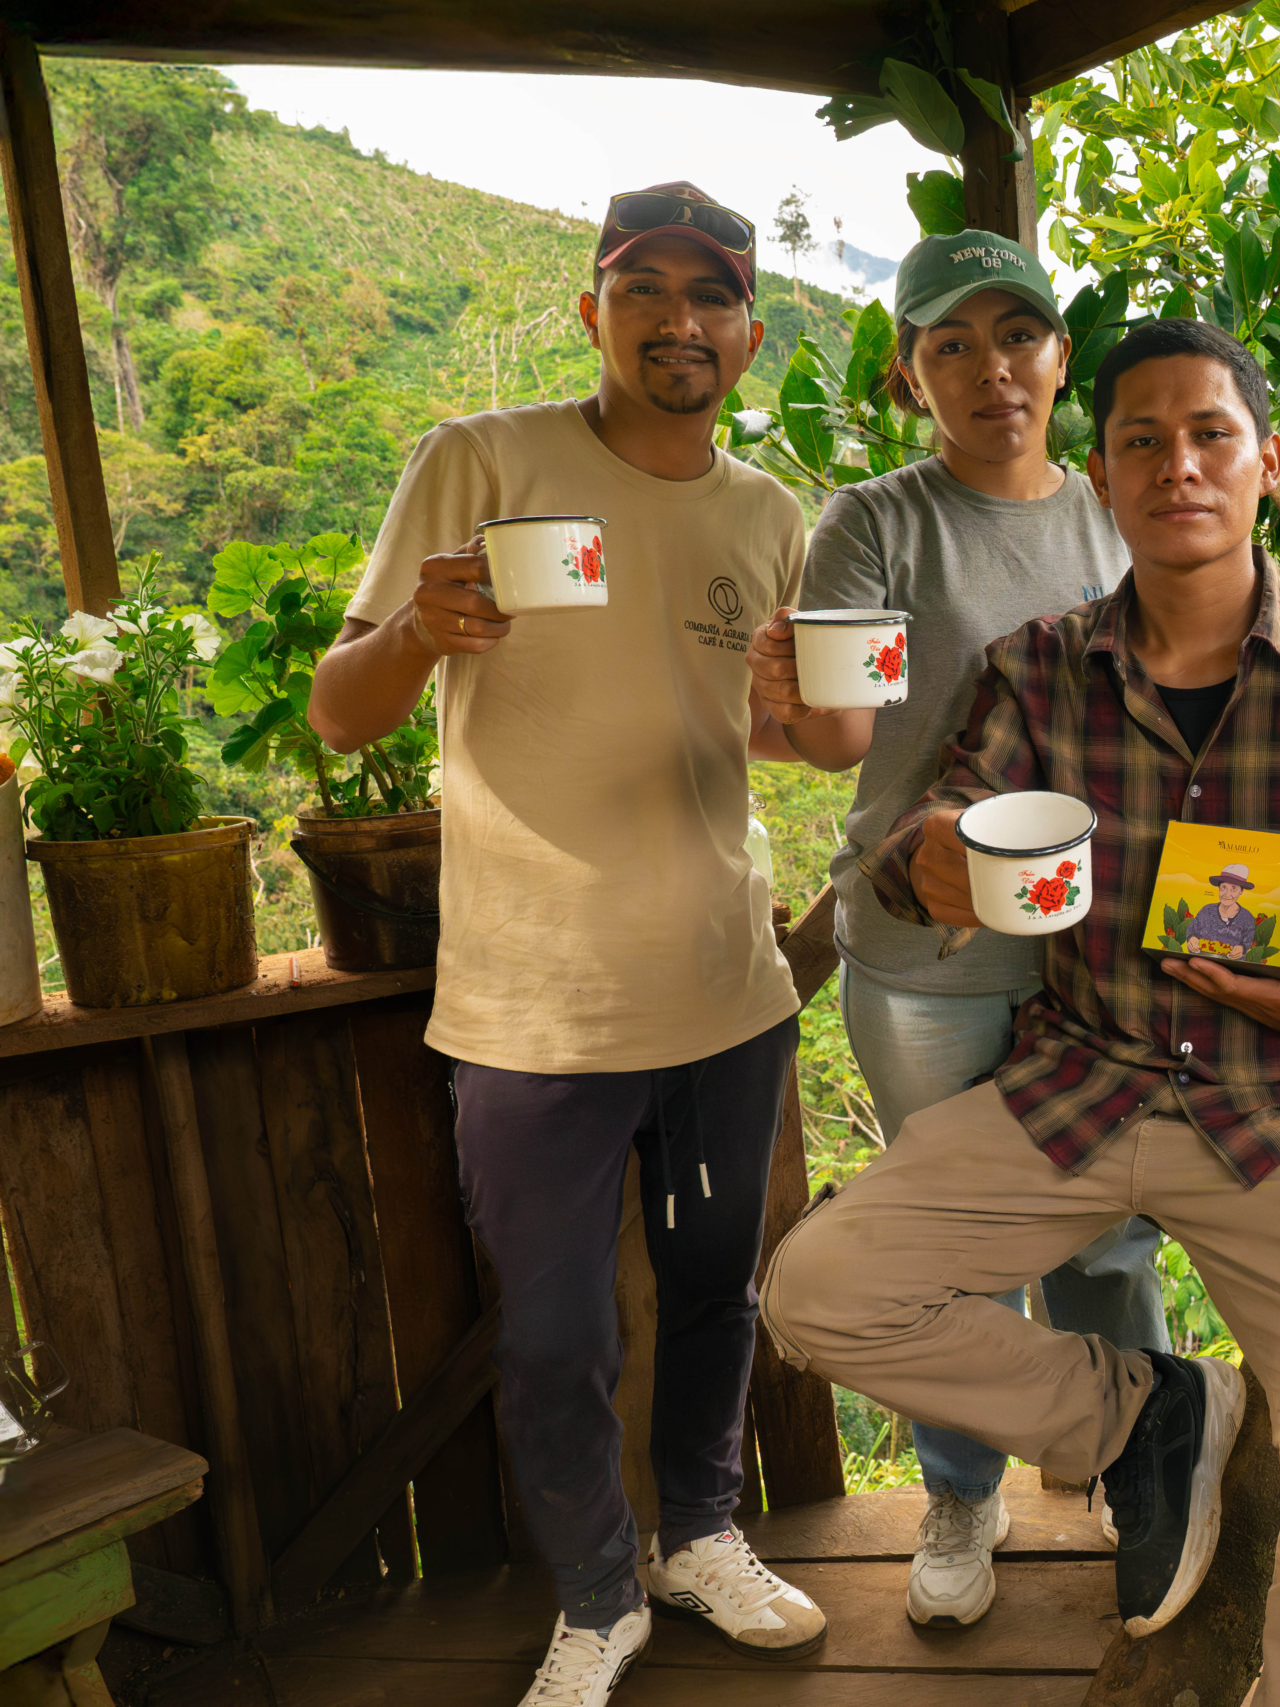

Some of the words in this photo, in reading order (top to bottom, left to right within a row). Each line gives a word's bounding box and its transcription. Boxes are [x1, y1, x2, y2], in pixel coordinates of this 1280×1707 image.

[949, 247, 986, 264] NEW
[988, 246, 1027, 273] YORK
[981, 257, 1002, 269] 08
[684, 620, 720, 636] COMPAÑÍA
[698, 635, 717, 647] CAFÉ
[719, 639, 724, 648] &
[726, 640, 747, 653] CACAO
[1219, 840, 1260, 854] AMARILLO
